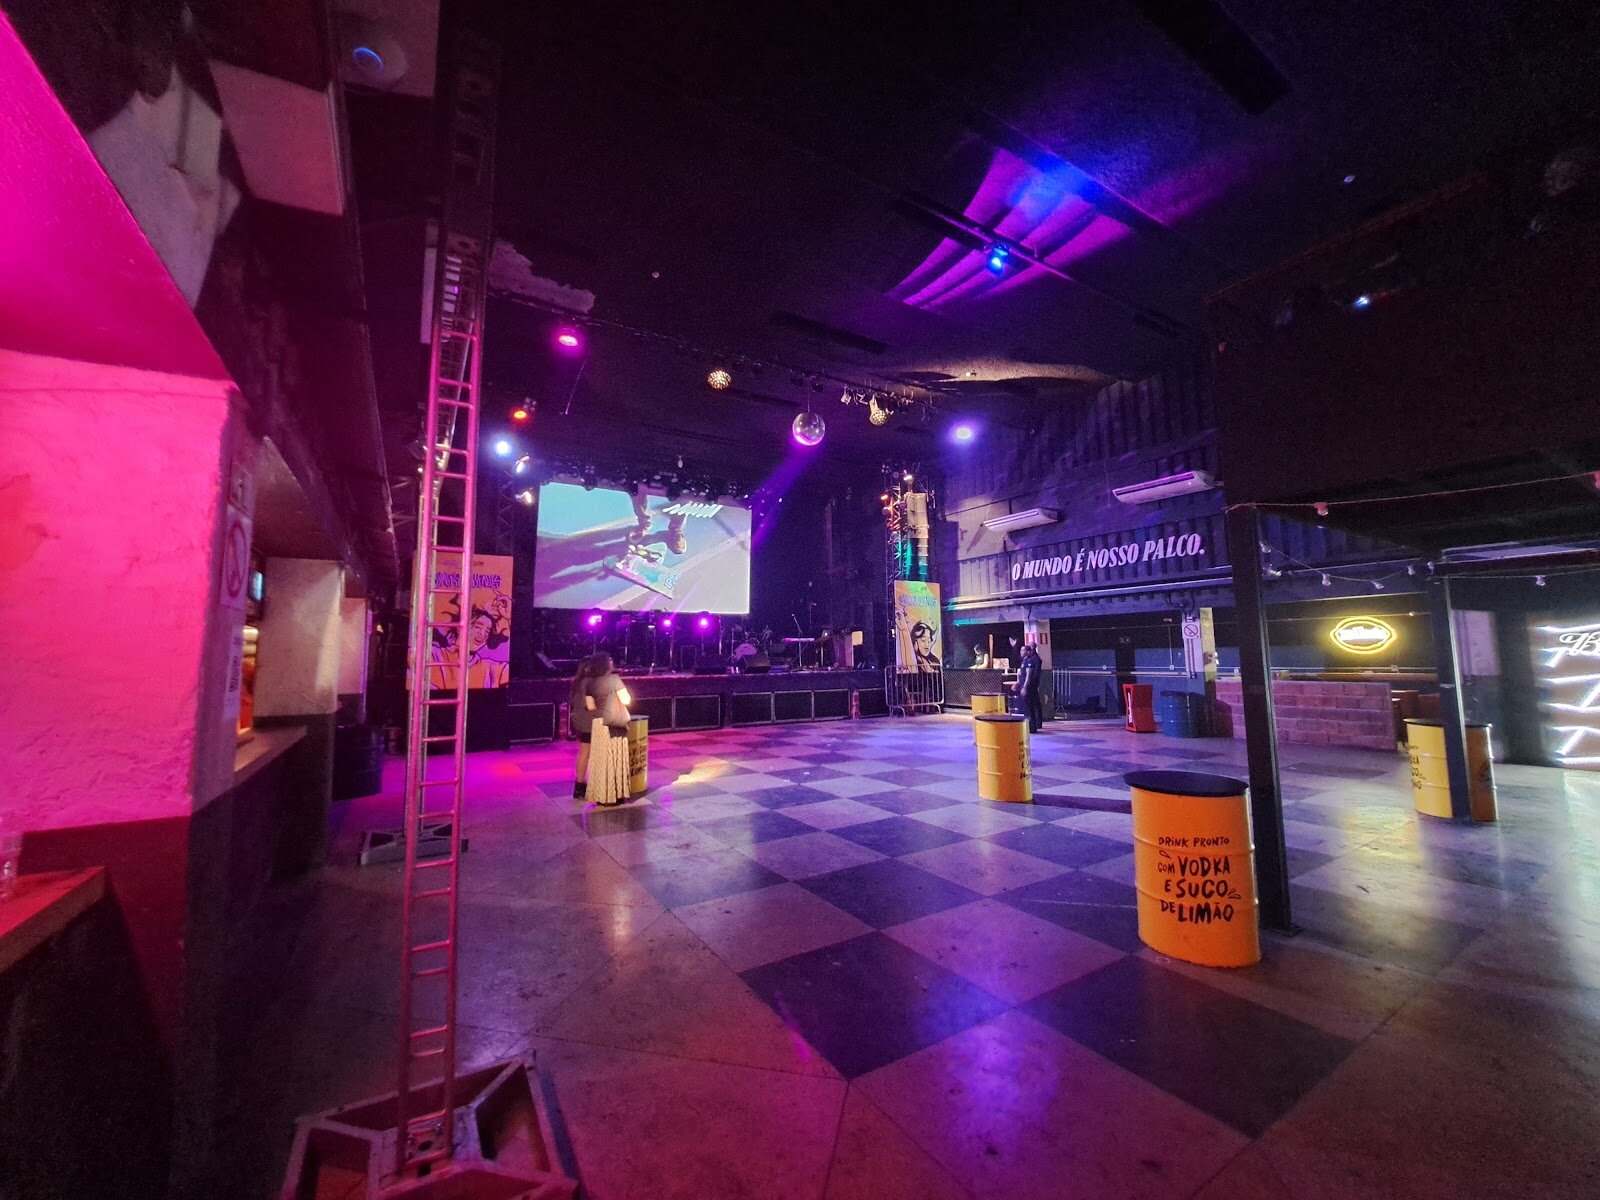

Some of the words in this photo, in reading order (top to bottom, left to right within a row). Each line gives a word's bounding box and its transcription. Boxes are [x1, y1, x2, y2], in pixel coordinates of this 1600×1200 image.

[1011, 563, 1021, 581] O
[1022, 555, 1072, 579] MUNDO
[1073, 548, 1085, 572] É
[1086, 543, 1140, 570] NOSSO
[1142, 533, 1205, 562] PALCO.
[1193, 836, 1230, 847] PRONTO
[1157, 862, 1175, 875] COM
[1178, 855, 1230, 877] VODKA
[1164, 879, 1172, 892] E
[1176, 879, 1228, 898] SUCO
[1160, 899, 1176, 913] DE
[1177, 902, 1234, 924] LIMÃO
